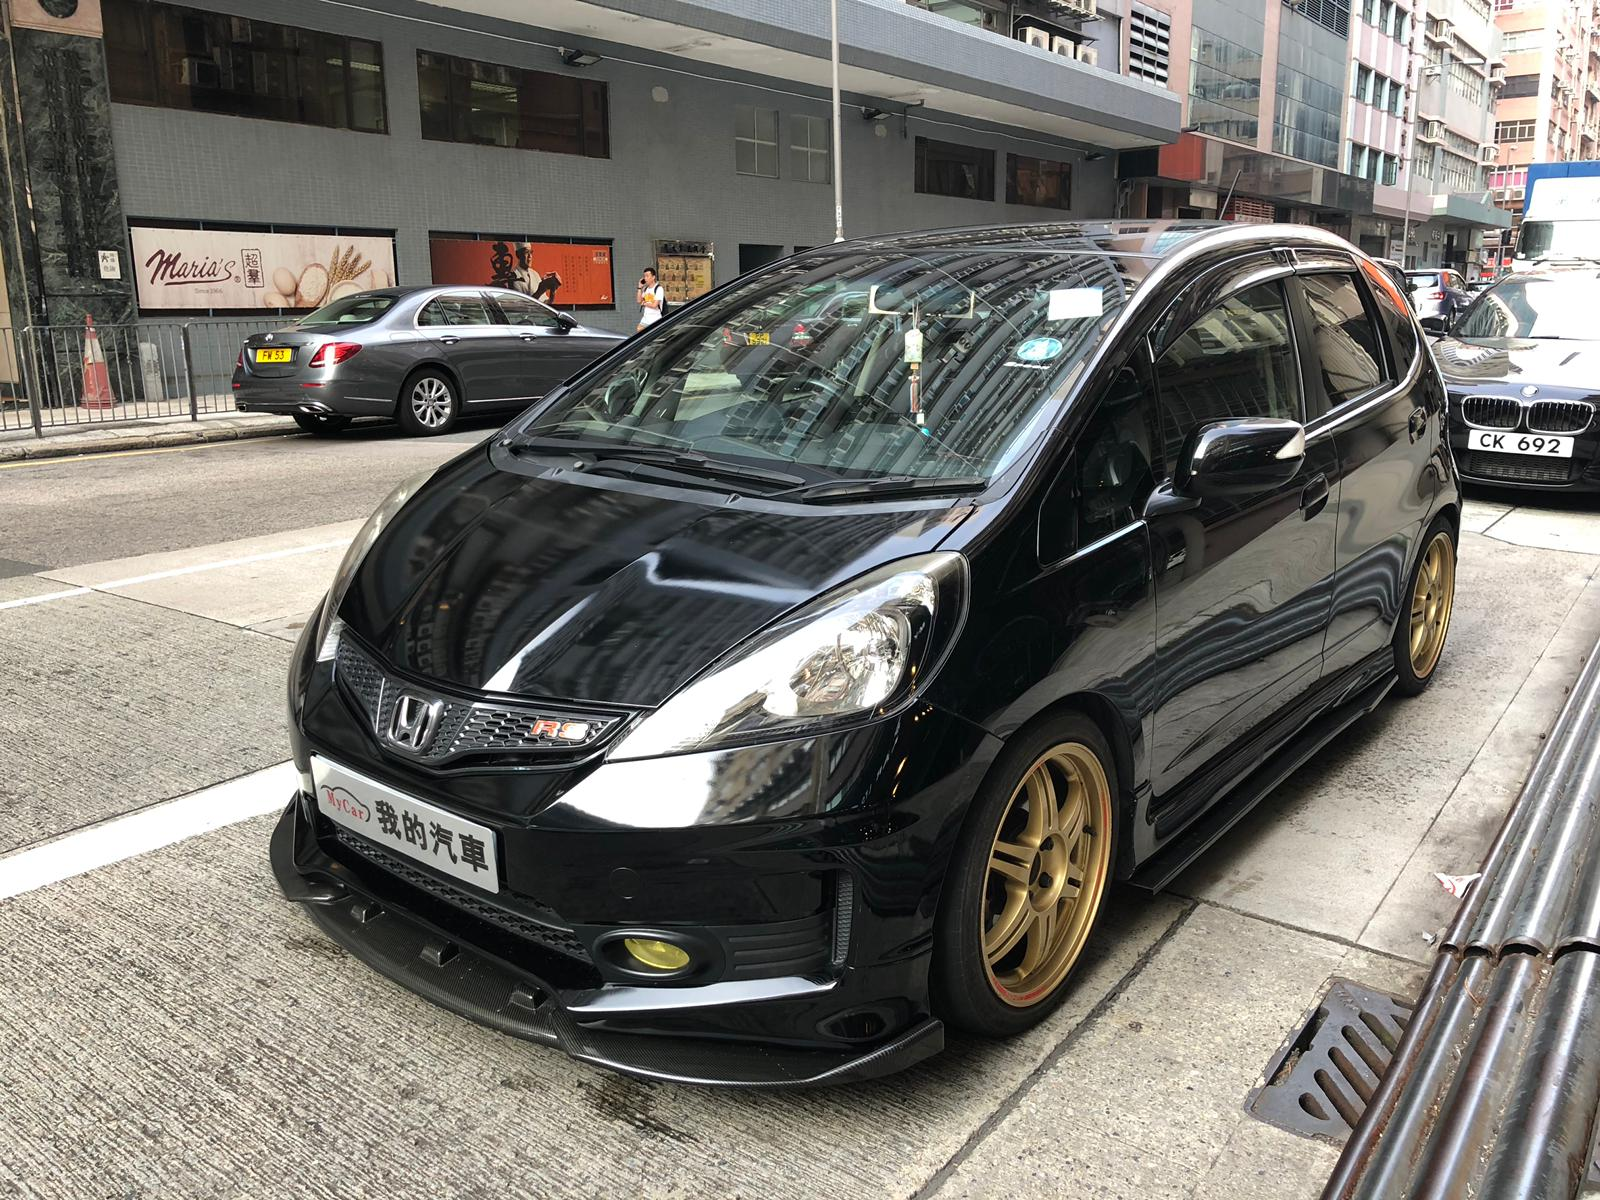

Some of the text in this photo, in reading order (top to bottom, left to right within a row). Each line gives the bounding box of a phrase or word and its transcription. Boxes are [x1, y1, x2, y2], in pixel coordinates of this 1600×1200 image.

[145, 249, 235, 285] Maria's
[263, 350, 284, 360] FW 53
[1480, 433, 1560, 454] CK 692
[326, 789, 365, 820] MyCar
[375, 799, 489, 873] 我的汽車
